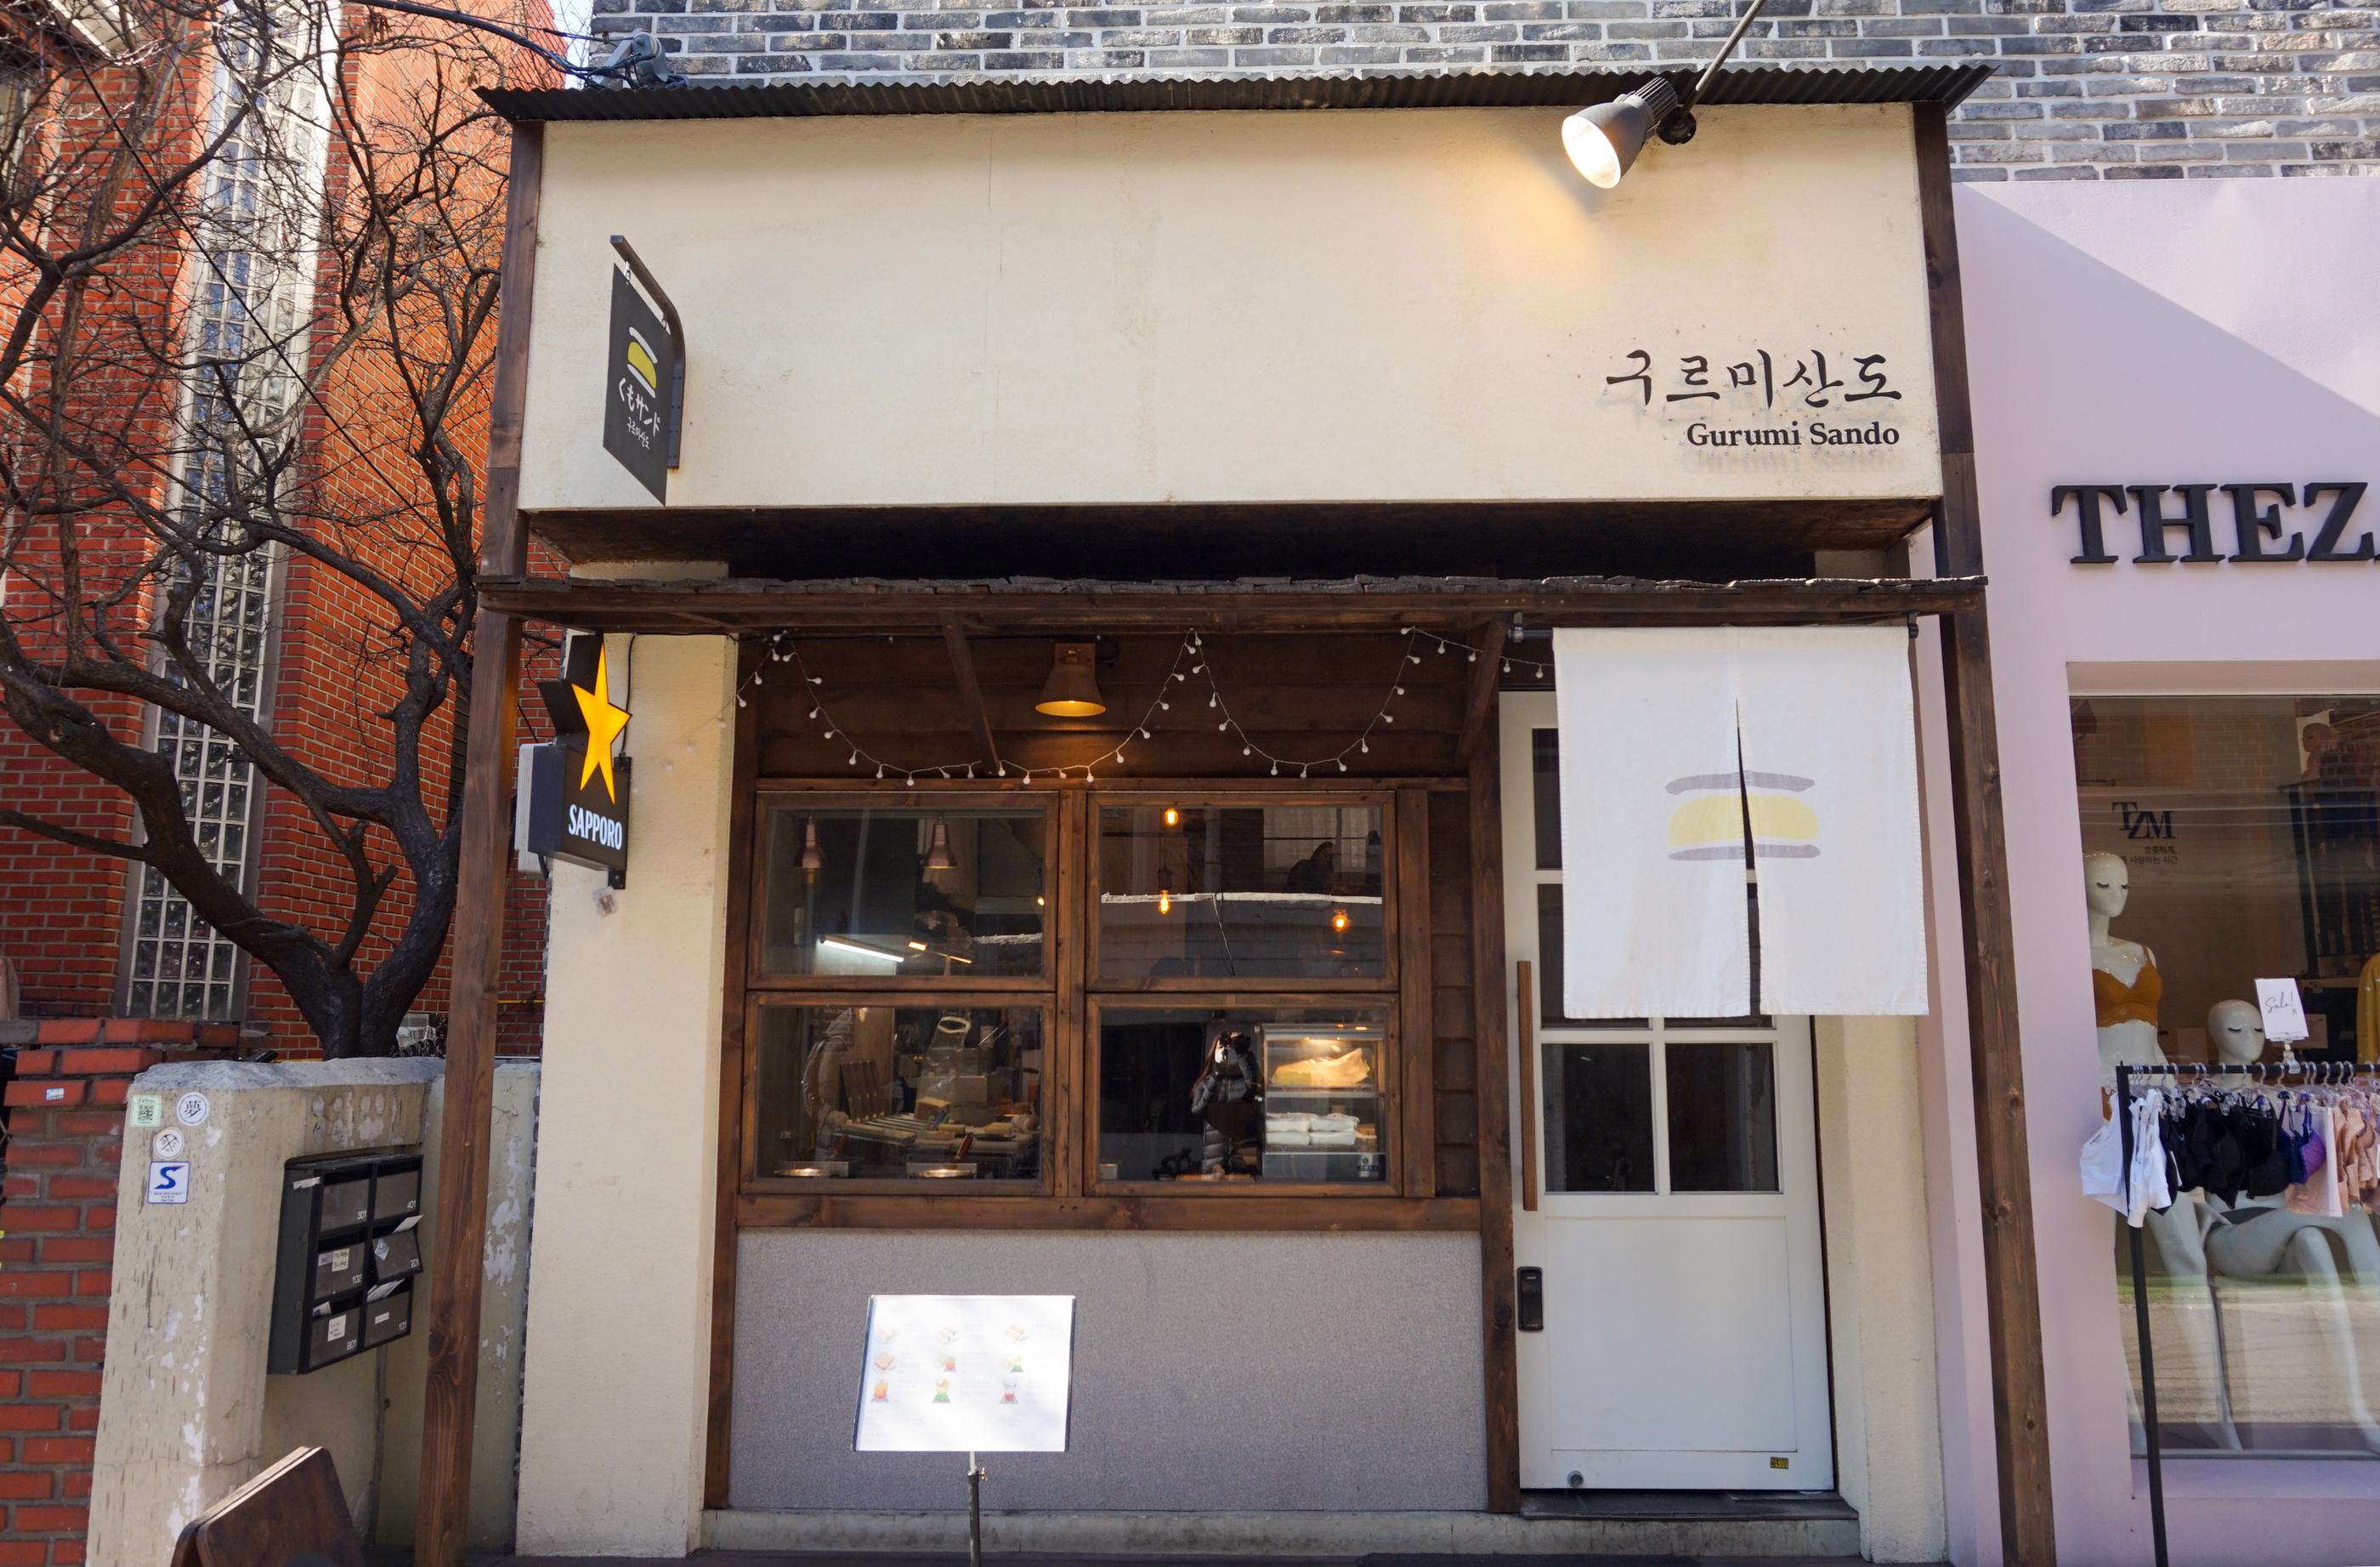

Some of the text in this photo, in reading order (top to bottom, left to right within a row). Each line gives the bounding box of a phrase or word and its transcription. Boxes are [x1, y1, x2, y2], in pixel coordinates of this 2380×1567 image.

[1606, 349, 1902, 409] 구르미산도
[626, 416, 649, 450] 구르미산도
[1686, 420, 1901, 446] Gurumi Sando
[568, 803, 622, 850] SAPPORO
